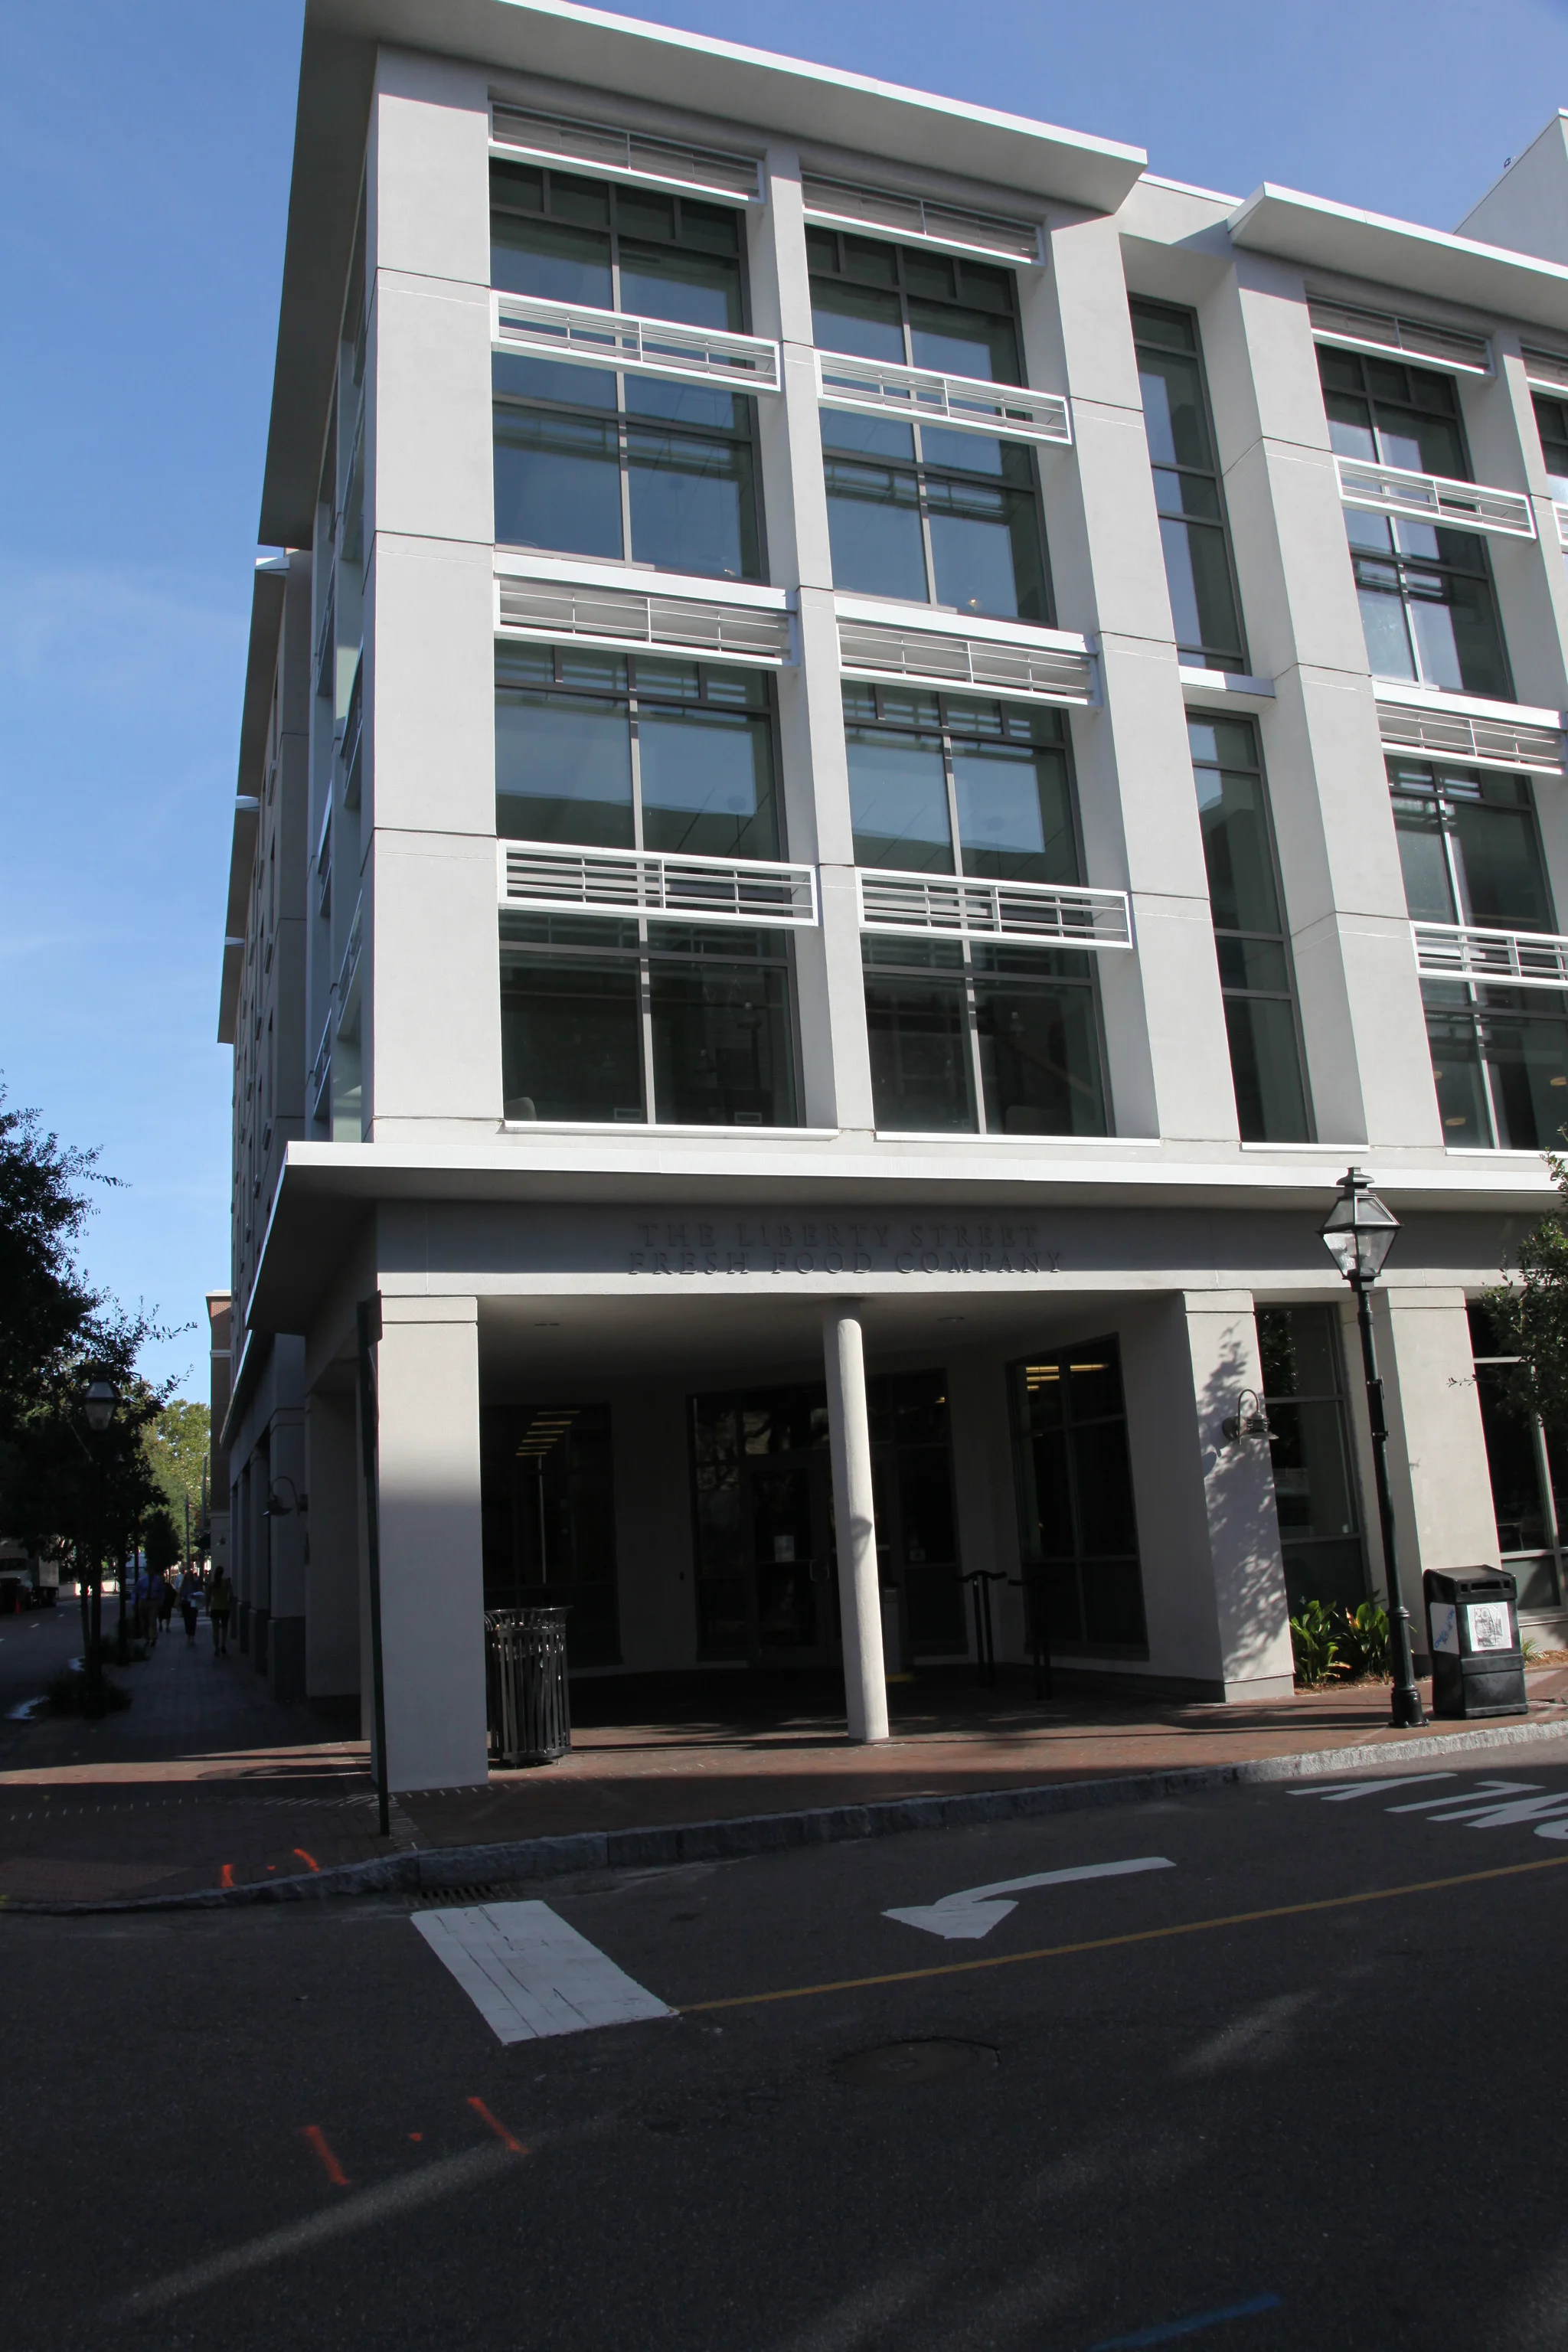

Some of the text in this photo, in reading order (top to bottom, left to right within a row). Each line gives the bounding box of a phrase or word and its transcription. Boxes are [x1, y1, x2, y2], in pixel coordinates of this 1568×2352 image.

[640, 1223, 1038, 1247] THE LIBERTY STREET
[629, 1251, 1062, 1275] FRESH FOOD COMPANY
[1285, 1772, 1568, 1840] NLY
